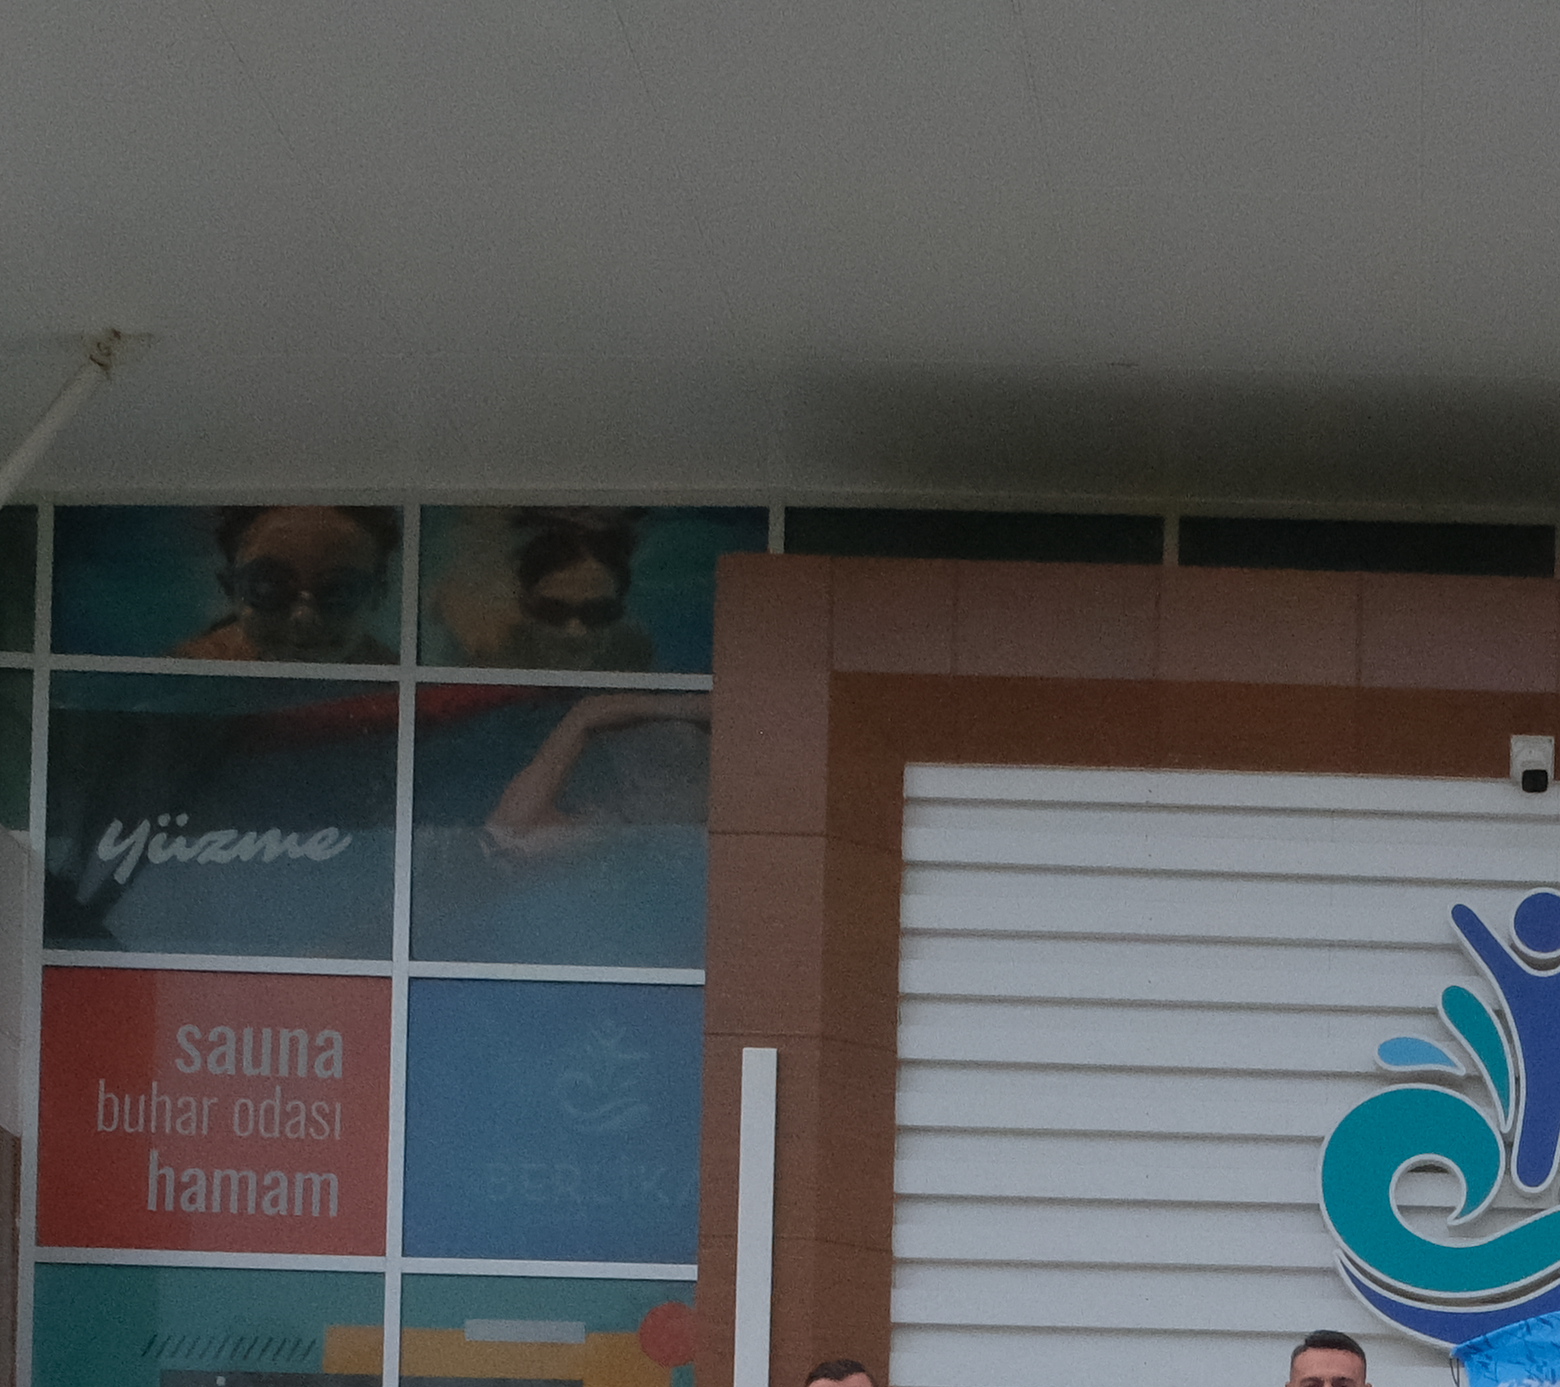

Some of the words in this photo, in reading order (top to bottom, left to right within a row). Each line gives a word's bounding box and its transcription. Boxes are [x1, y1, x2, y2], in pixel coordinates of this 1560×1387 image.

[174, 1023, 344, 1079] sauna
[96, 1077, 219, 1138] buhar
[232, 1084, 342, 1141] odası
[146, 1148, 340, 1218] hamam
